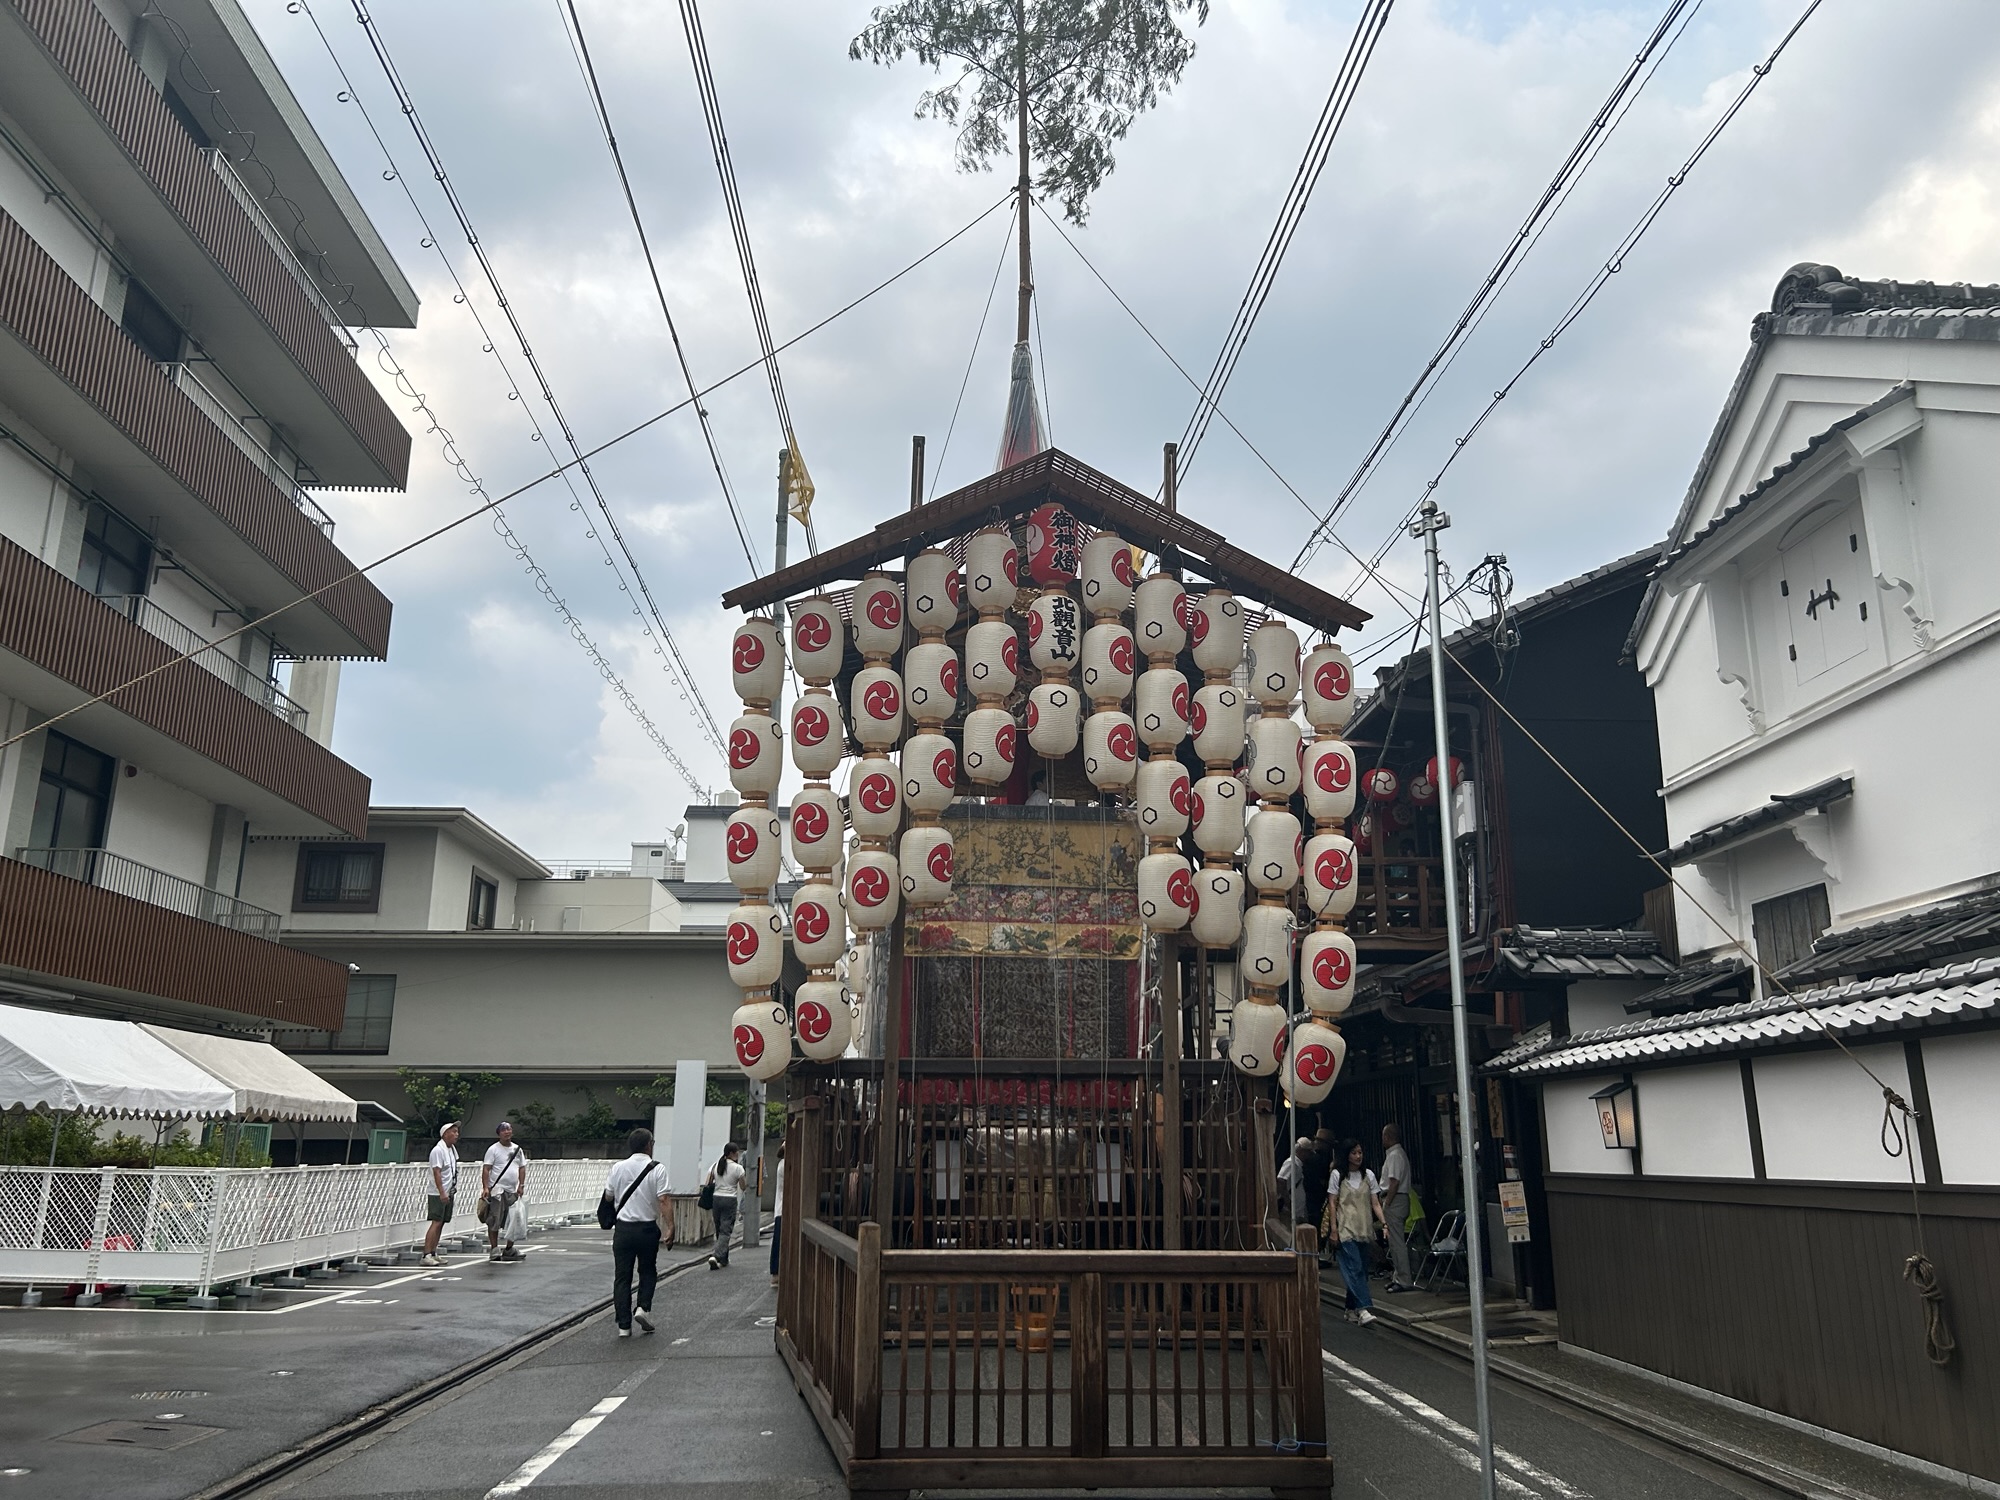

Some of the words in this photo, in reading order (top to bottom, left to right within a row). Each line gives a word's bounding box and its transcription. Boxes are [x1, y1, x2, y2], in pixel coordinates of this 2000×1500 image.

[1049, 509, 1078, 574] 御神燈
[1049, 596, 1077, 662] 北觀音山
